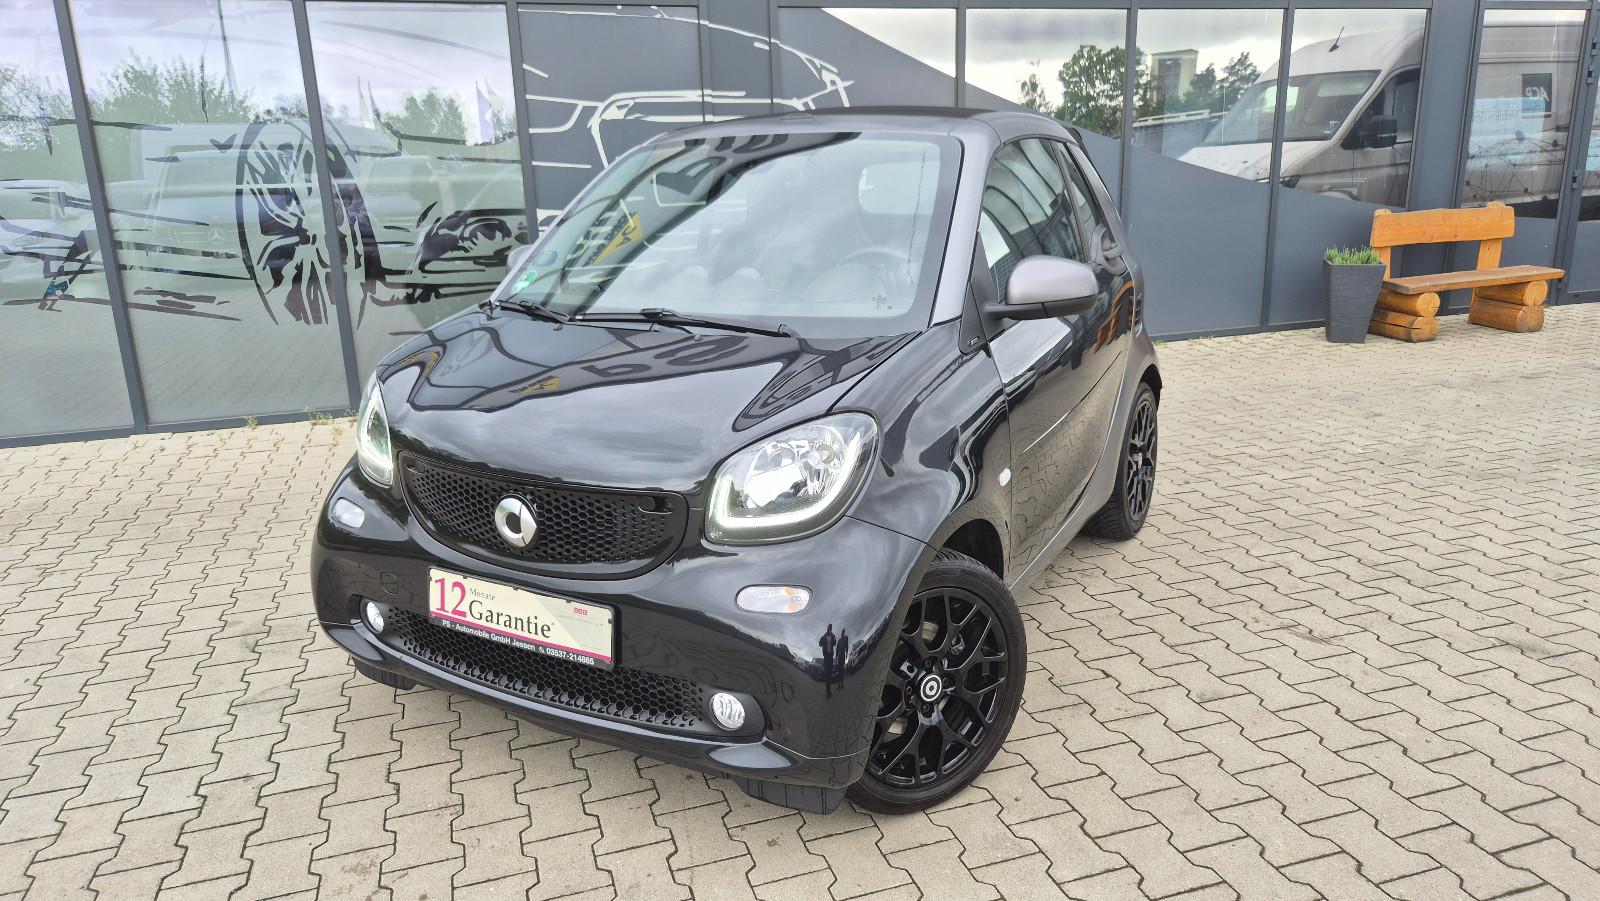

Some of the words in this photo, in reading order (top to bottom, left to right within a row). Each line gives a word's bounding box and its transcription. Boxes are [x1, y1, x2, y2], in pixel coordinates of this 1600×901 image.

[435, 578, 467, 618] 12
[470, 588, 496, 601] Monate
[442, 619, 451, 628] PS
[456, 624, 490, 639] Automobile
[491, 633, 511, 645] GmbH
[512, 639, 536, 651] Jessen
